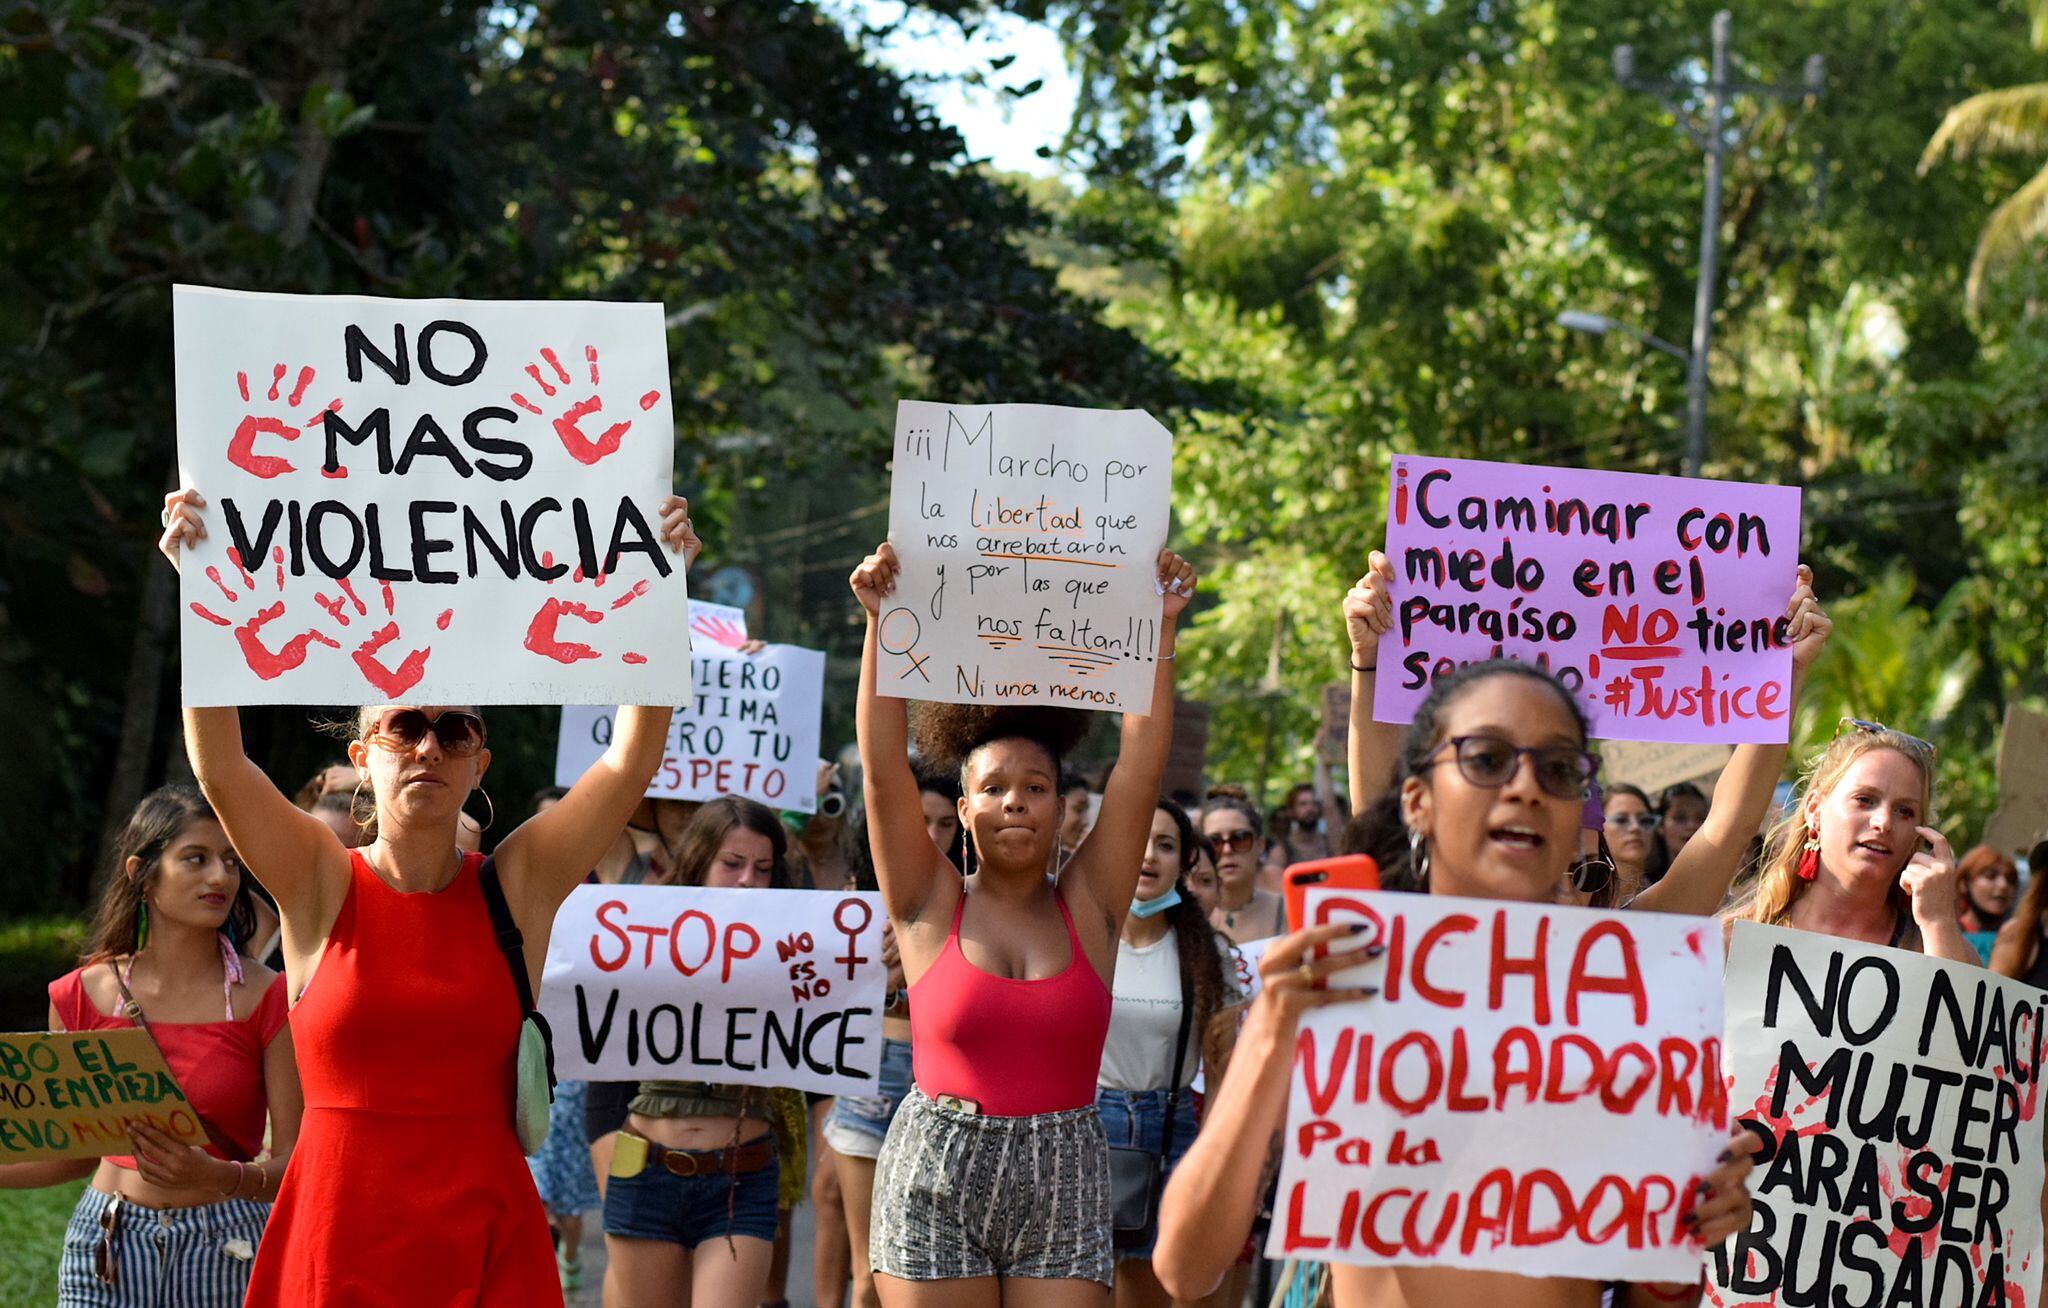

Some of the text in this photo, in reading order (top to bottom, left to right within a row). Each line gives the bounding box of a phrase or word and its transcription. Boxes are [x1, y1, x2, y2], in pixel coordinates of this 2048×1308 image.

[345, 320, 488, 386] NO
[323, 407, 533, 481] MAS
[1105, 459, 1148, 502] por
[922, 482, 1137, 541] la libertad que
[1677, 507, 1771, 559] con
[221, 496, 672, 584] VIOLENCIA
[927, 533, 959, 549] nos
[931, 557, 1109, 620] y por las que
[1405, 536, 1704, 606] miedo en el
[977, 608, 1154, 662] nos faltan!!!
[1400, 596, 1793, 656] paraíso NO tiene
[692, 658, 781, 692] IERO
[956, 665, 1122, 707] Ni una menos.
[1604, 665, 1788, 727] #Justice
[674, 694, 778, 725] TIMA
[748, 730, 792, 762] TU
[649, 758, 785, 798] SPETO
[590, 900, 761, 984] STOP
[776, 931, 815, 962] NO
[1314, 897, 1648, 1027] PICHA
[789, 960, 819, 981] ES
[792, 978, 831, 1003] NO
[1763, 944, 1900, 1046] NO
[73, 1039, 137, 1077] EL
[575, 984, 873, 1079] VIOLENCE
[44, 1070, 187, 1110] EMPIEZA
[1294, 1026, 1729, 1131] VIOLADORA
[1770, 1040, 2021, 1164] MUJER
[1298, 1121, 1442, 1168] Pa la
[1892, 1151, 2010, 1248] SER
